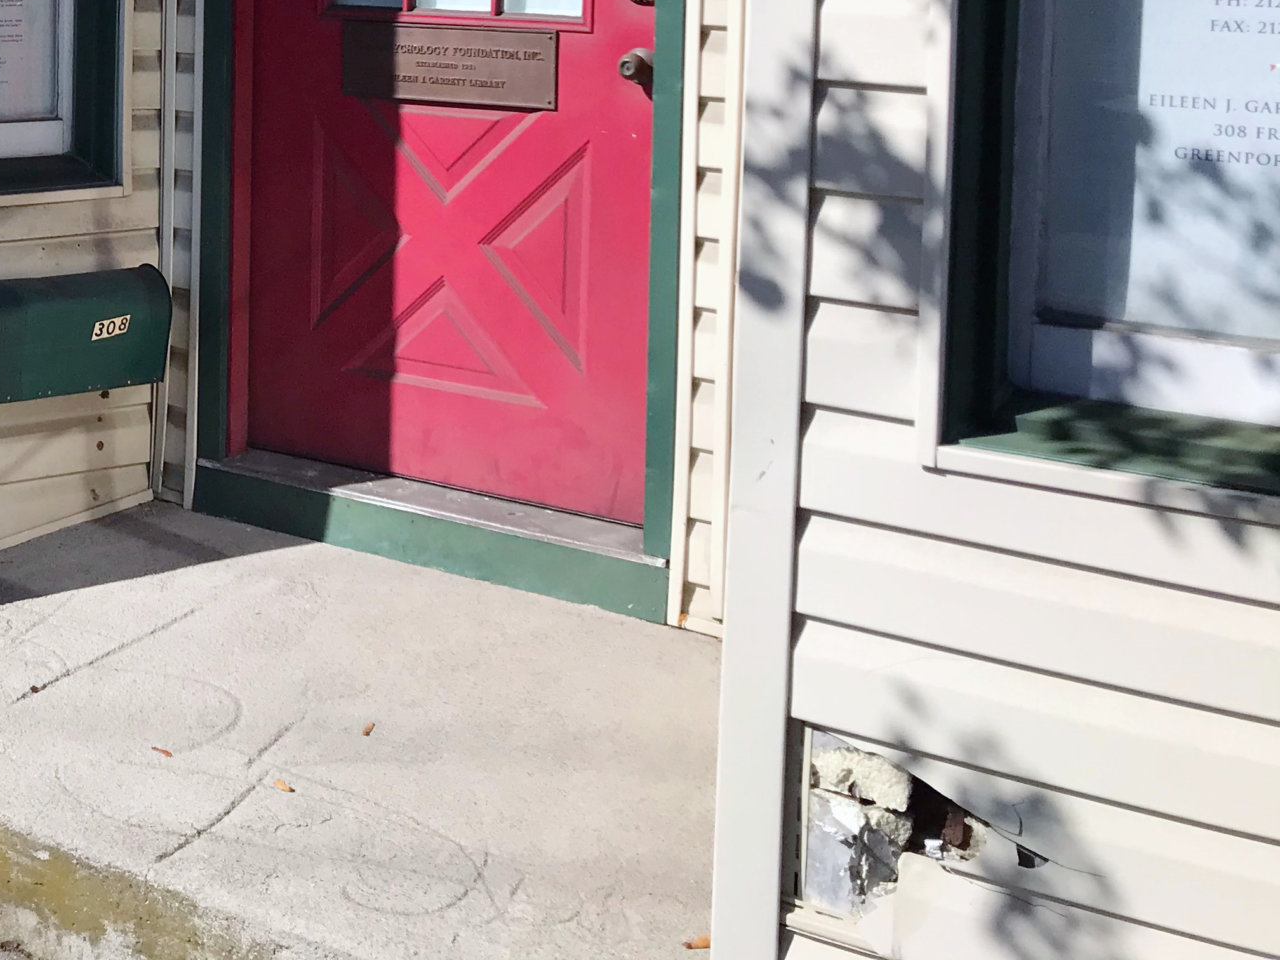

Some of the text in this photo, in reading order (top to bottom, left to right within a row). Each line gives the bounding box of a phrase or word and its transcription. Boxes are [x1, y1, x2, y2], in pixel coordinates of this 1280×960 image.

[1210, 19, 1250, 33] FAX:
[1149, 94, 1216, 110] EILEEN
[1225, 98, 1237, 114] J.
[1213, 123, 1247, 138] 308
[94, 317, 128, 338] 308
